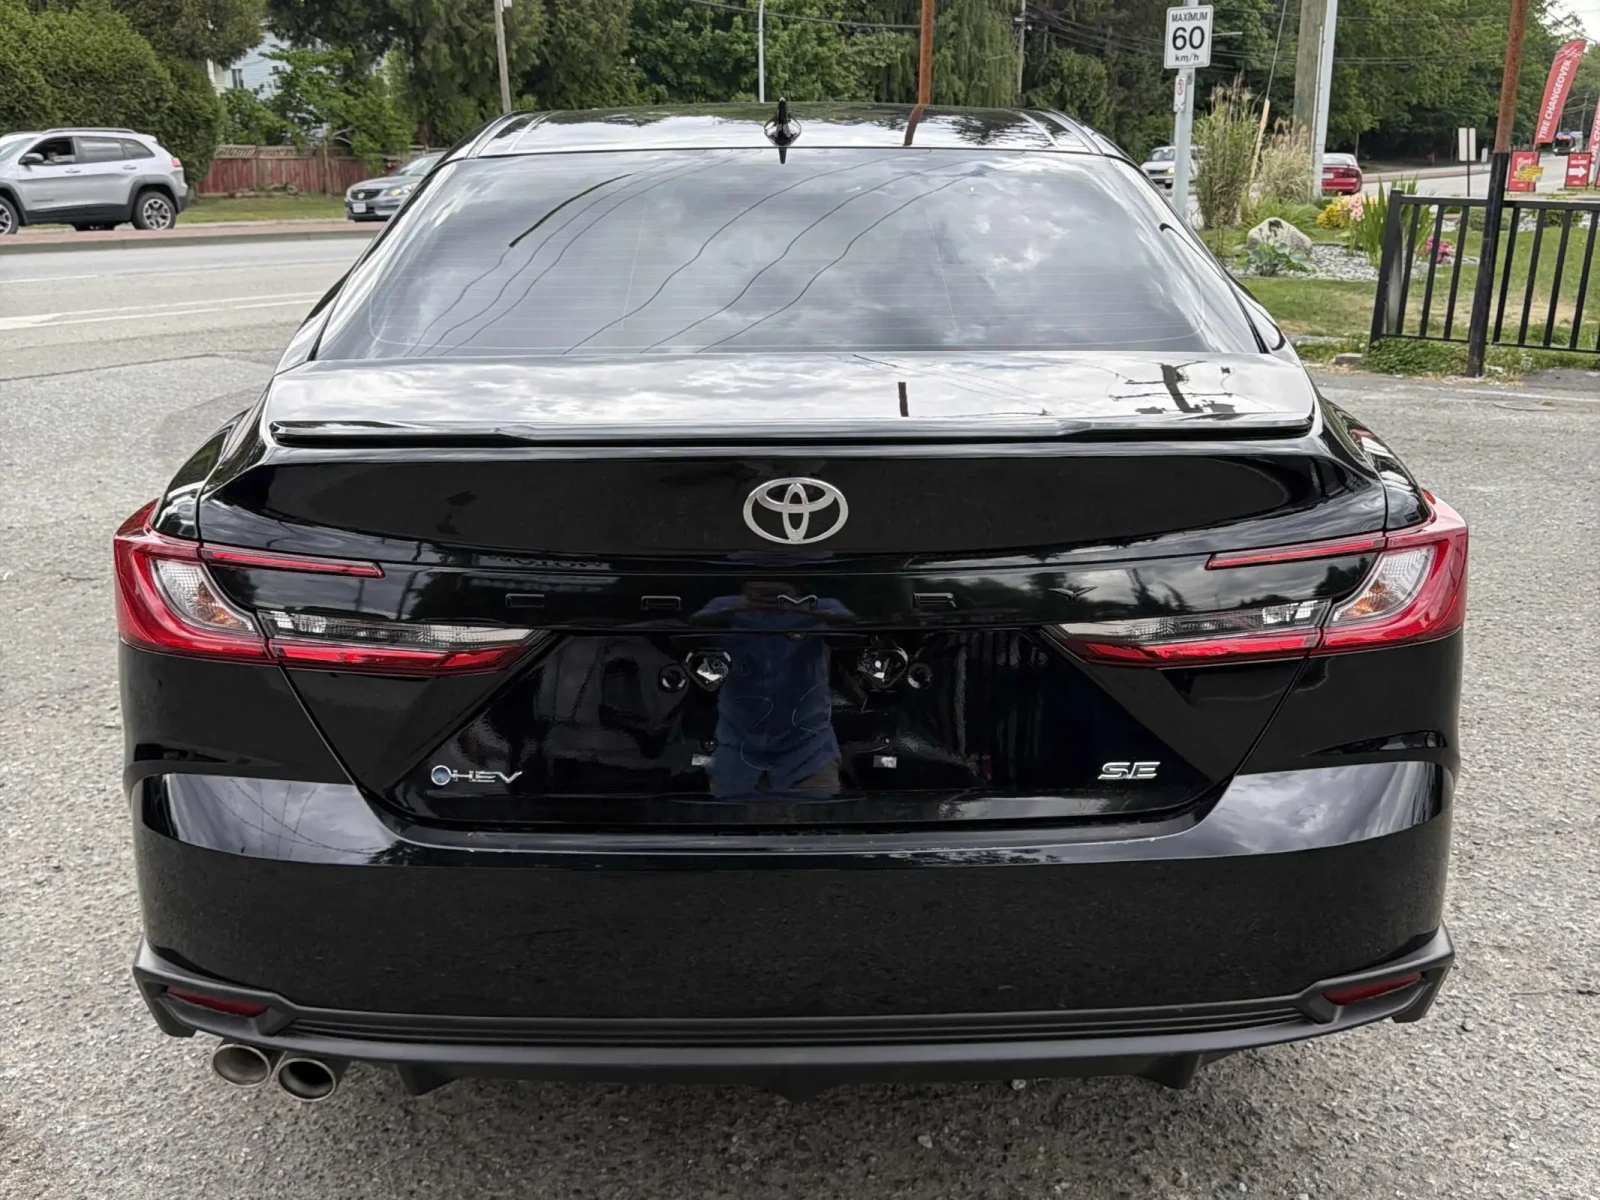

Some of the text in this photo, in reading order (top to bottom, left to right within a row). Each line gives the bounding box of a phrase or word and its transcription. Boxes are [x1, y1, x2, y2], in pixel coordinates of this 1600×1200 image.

[1172, 12, 1208, 22] MAXIMUM
[1172, 26, 1205, 50] 60
[1175, 54, 1199, 62] km/h
[1538, 119, 1551, 139] TIRE
[1545, 60, 1572, 120] CHANGEOVER
[505, 586, 1098, 611] CAMRY
[1097, 761, 1161, 779] SE
